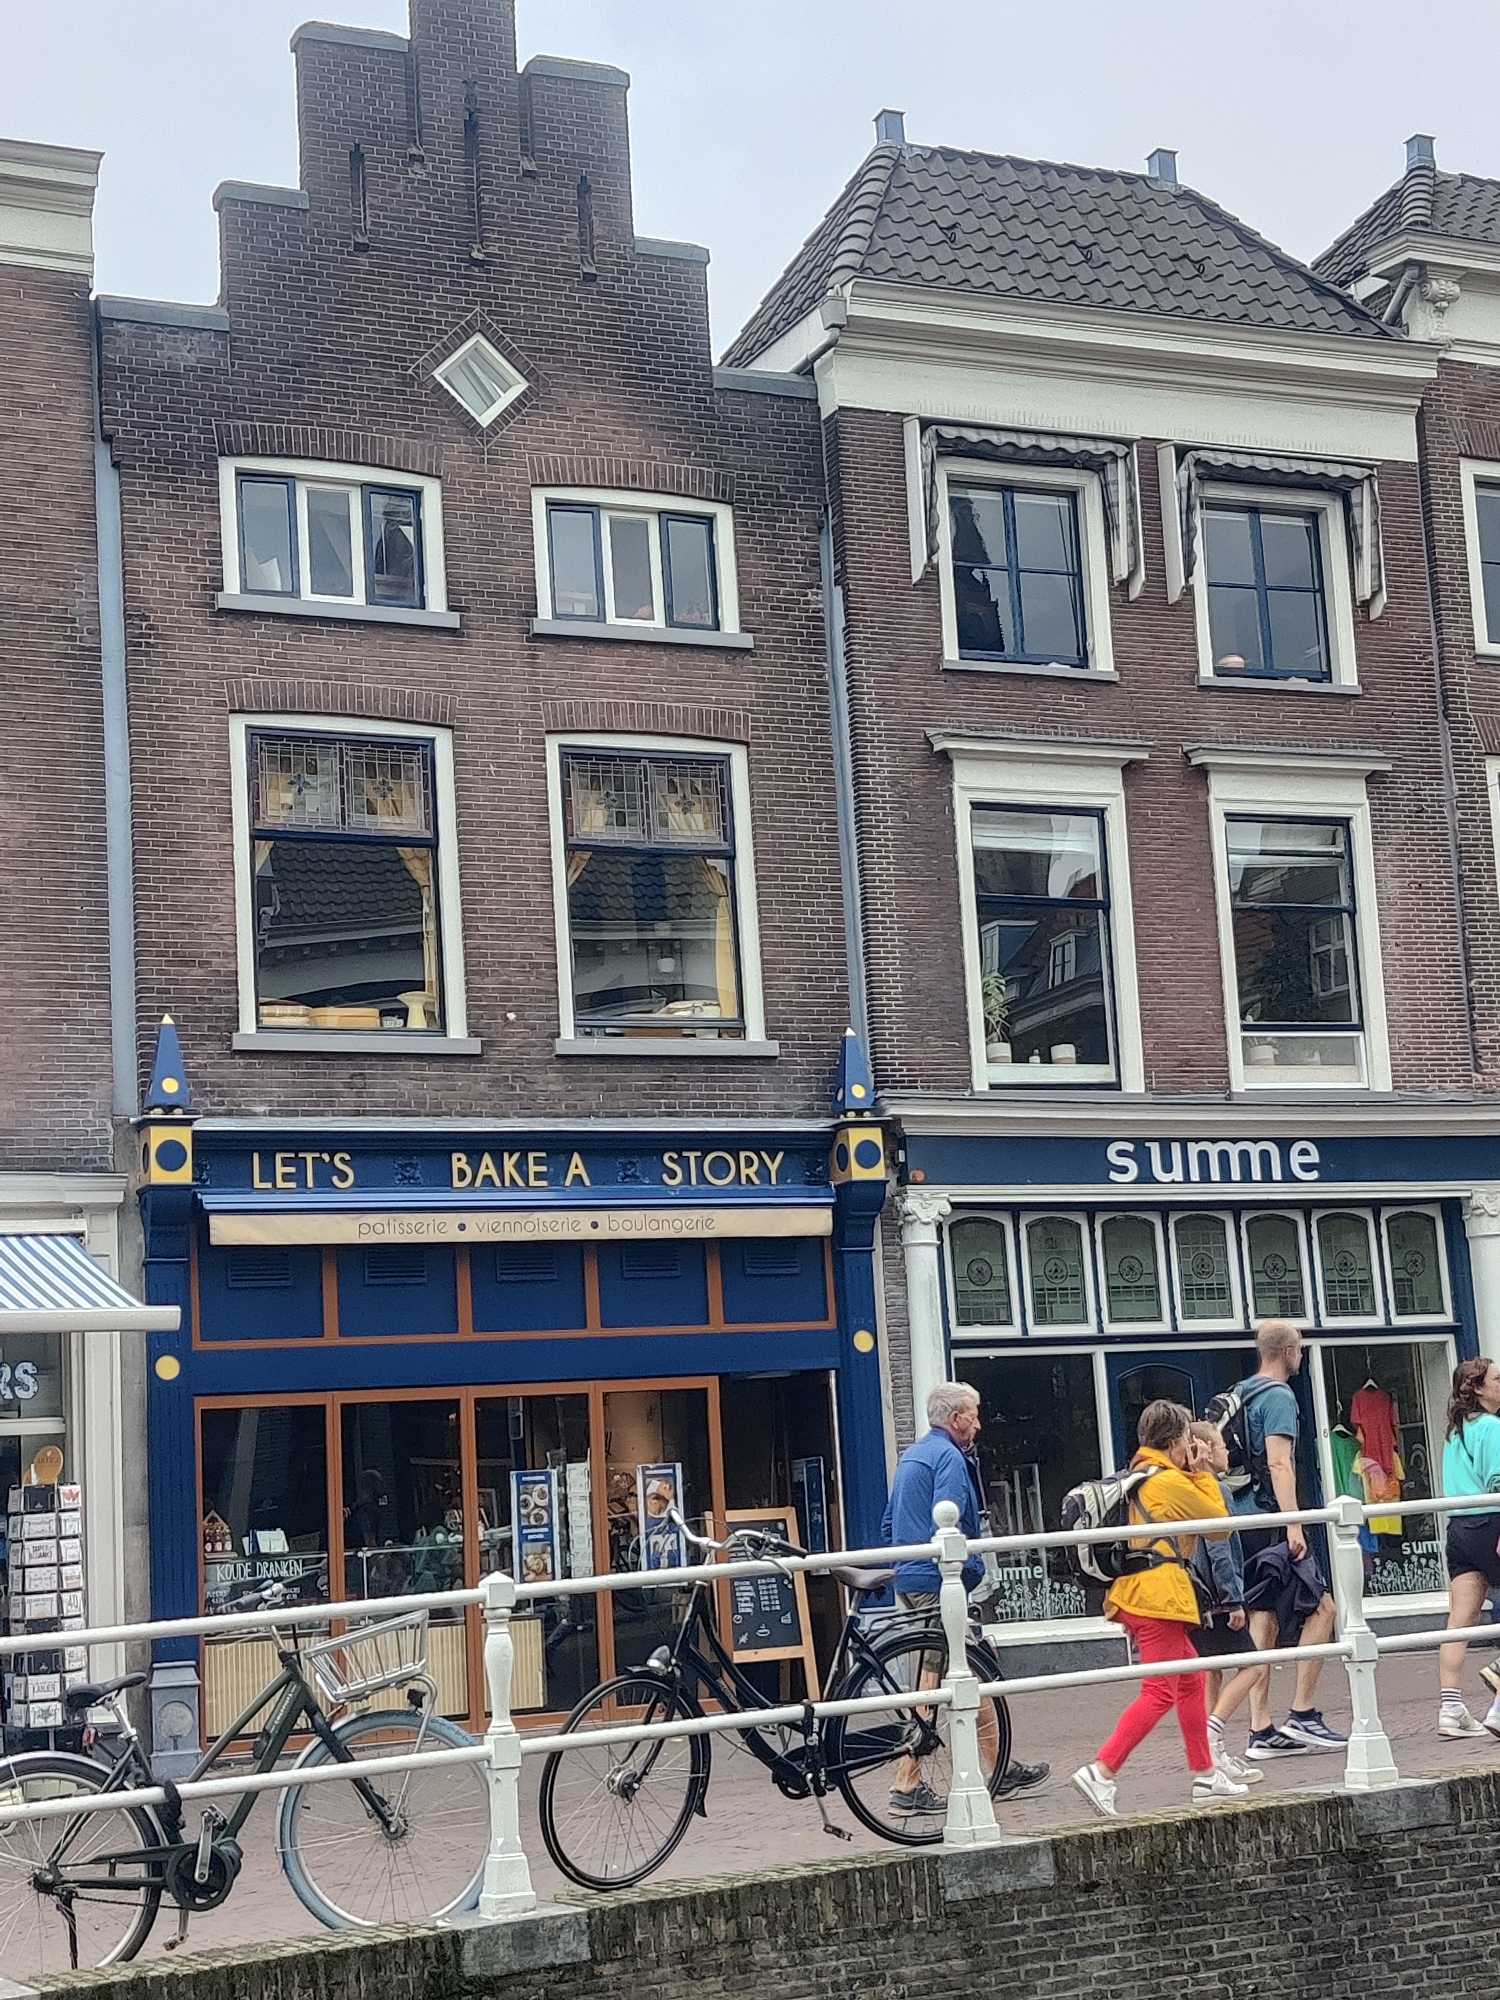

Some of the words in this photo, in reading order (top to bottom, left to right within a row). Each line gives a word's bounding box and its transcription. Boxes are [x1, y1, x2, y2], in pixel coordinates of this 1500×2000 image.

[252, 1151, 355, 1189] LET'S
[451, 1151, 549, 1188] BAKE
[564, 1151, 592, 1187] A
[662, 1150, 785, 1187] STORY
[1106, 1140, 1320, 1183] summe
[358, 1218, 448, 1239] patisserie
[475, 1217, 582, 1234] viennoiserie
[607, 1214, 716, 1234] boulangerie
[216, 1562, 251, 1582] KOUDE
[256, 1559, 303, 1578] DRANKEN
